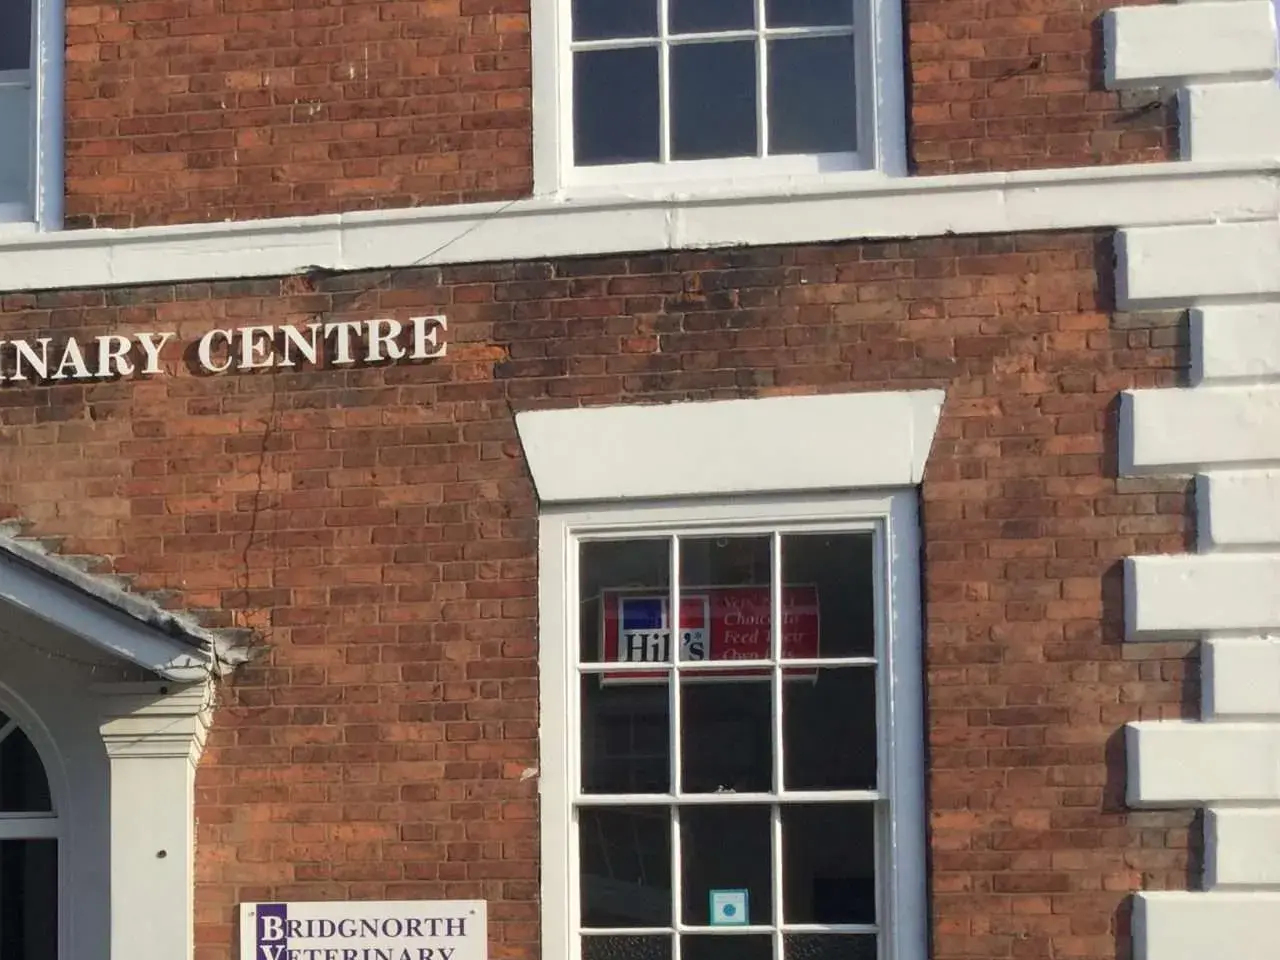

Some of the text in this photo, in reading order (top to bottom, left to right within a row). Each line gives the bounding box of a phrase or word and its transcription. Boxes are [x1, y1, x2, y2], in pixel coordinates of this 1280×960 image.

[198, 315, 448, 373] CENTRE
[624, 632, 704, 662] Hil's
[261, 915, 467, 942] BRIDGNORTH
